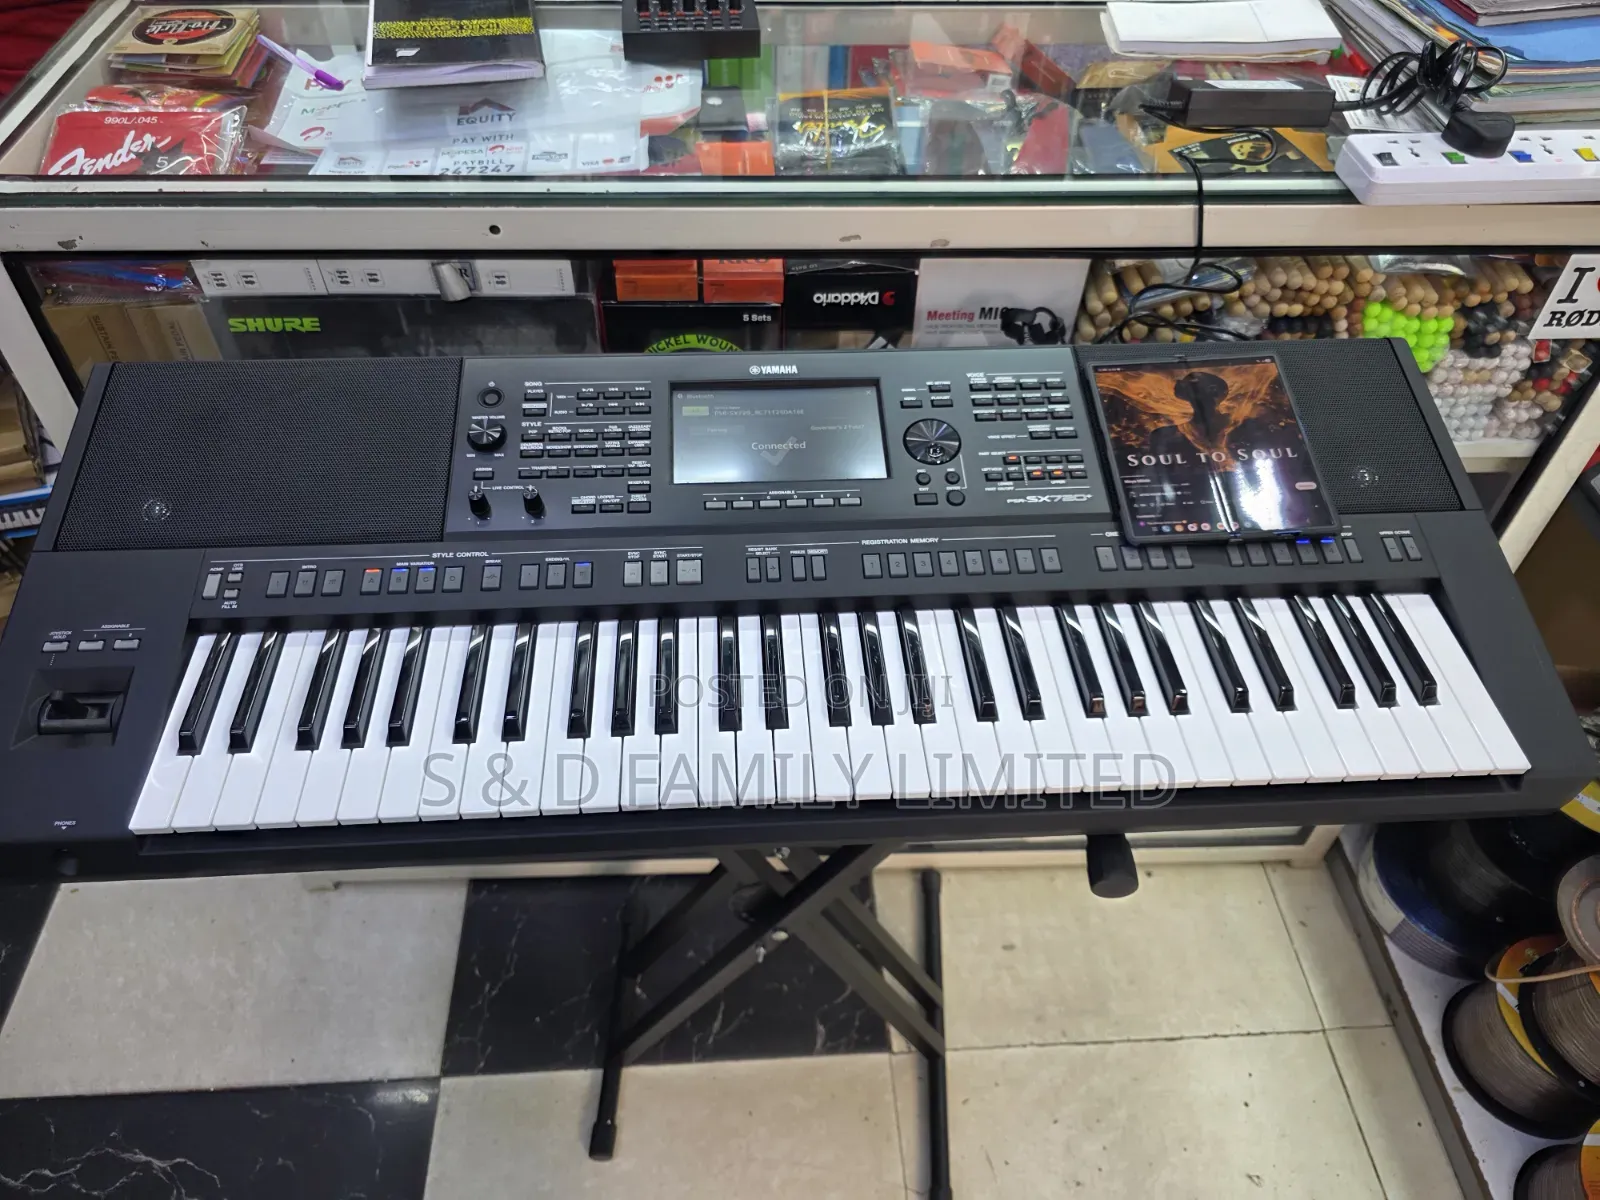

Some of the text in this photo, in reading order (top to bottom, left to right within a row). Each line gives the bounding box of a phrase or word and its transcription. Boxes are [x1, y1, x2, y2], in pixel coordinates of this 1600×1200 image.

[104, 116, 158, 125] 990L/.045
[457, 113, 516, 125] EQUITY
[453, 133, 514, 145] PAY WITH
[48, 130, 172, 174] Fender
[156, 156, 169, 168] 5
[440, 164, 515, 175] 247247
[1556, 266, 1596, 304] I
[813, 291, 880, 306] D'Addario
[751, 314, 771, 322] Sets
[926, 310, 975, 322] Meeting
[228, 317, 321, 333] SHURE
[696, 335, 738, 352] WOUN
[761, 365, 798, 375] YAMAHA
[751, 440, 807, 450] Connected
[1127, 448, 1298, 467] SOUL TO SOUL
